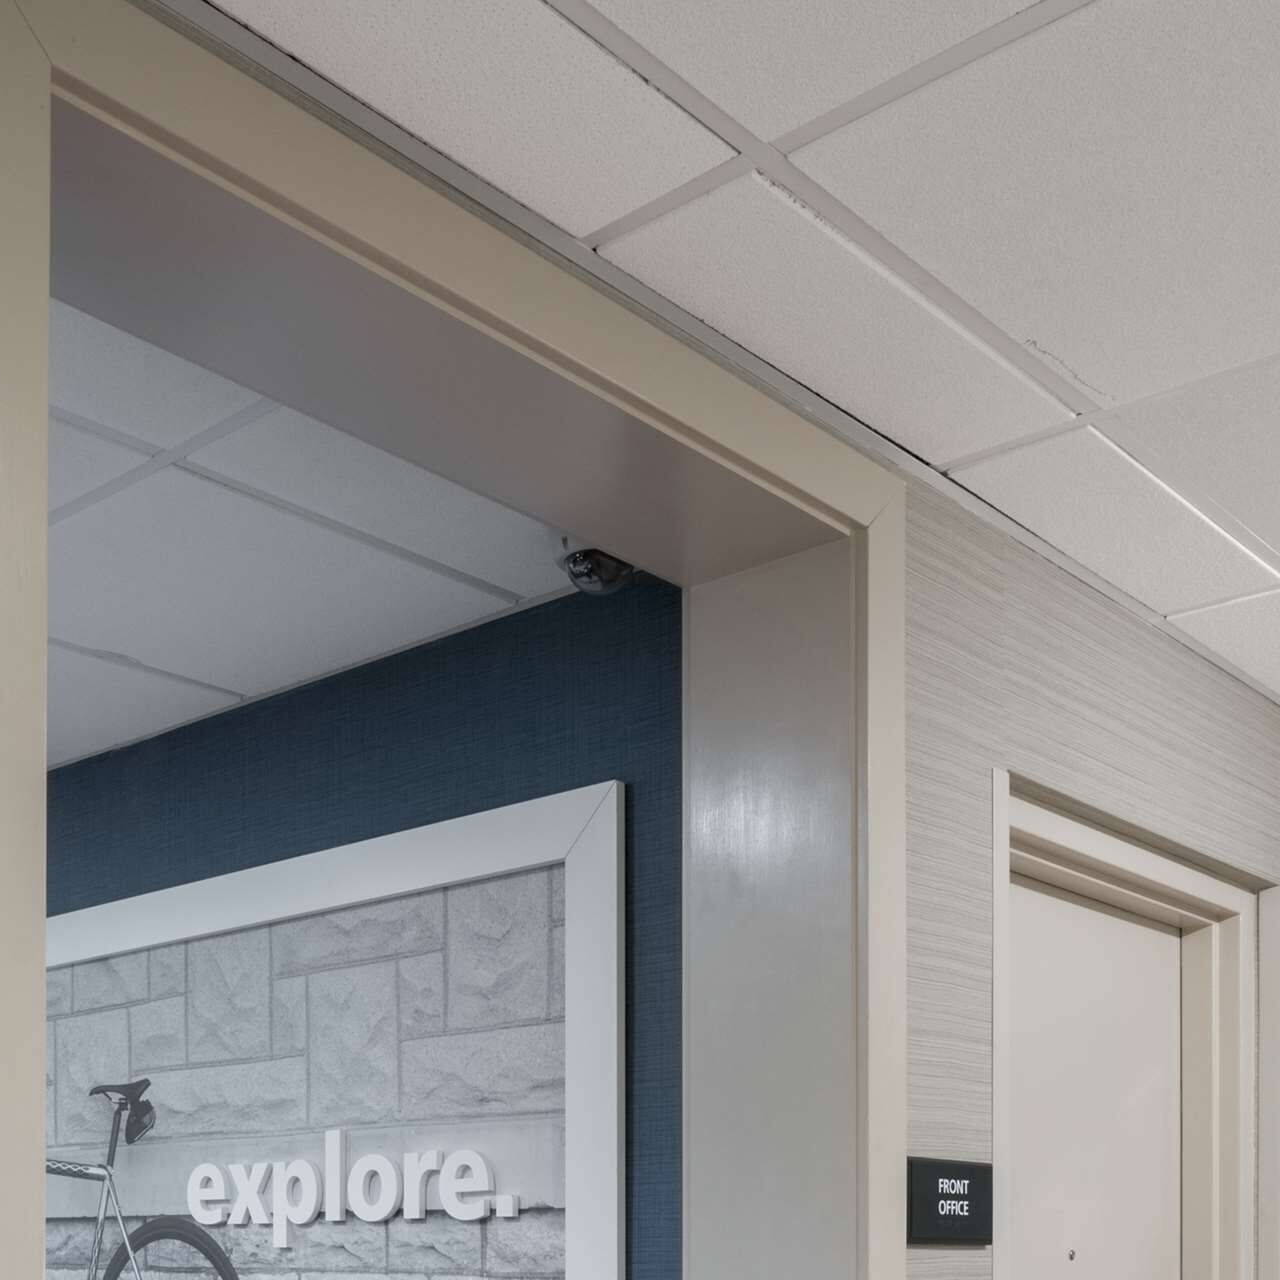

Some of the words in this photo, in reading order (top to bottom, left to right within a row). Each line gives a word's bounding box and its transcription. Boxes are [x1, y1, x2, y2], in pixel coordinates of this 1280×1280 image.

[186, 1130, 519, 1248] explore.
[938, 1178, 969, 1194] FRONT
[938, 1200, 969, 1216] OFFICE
